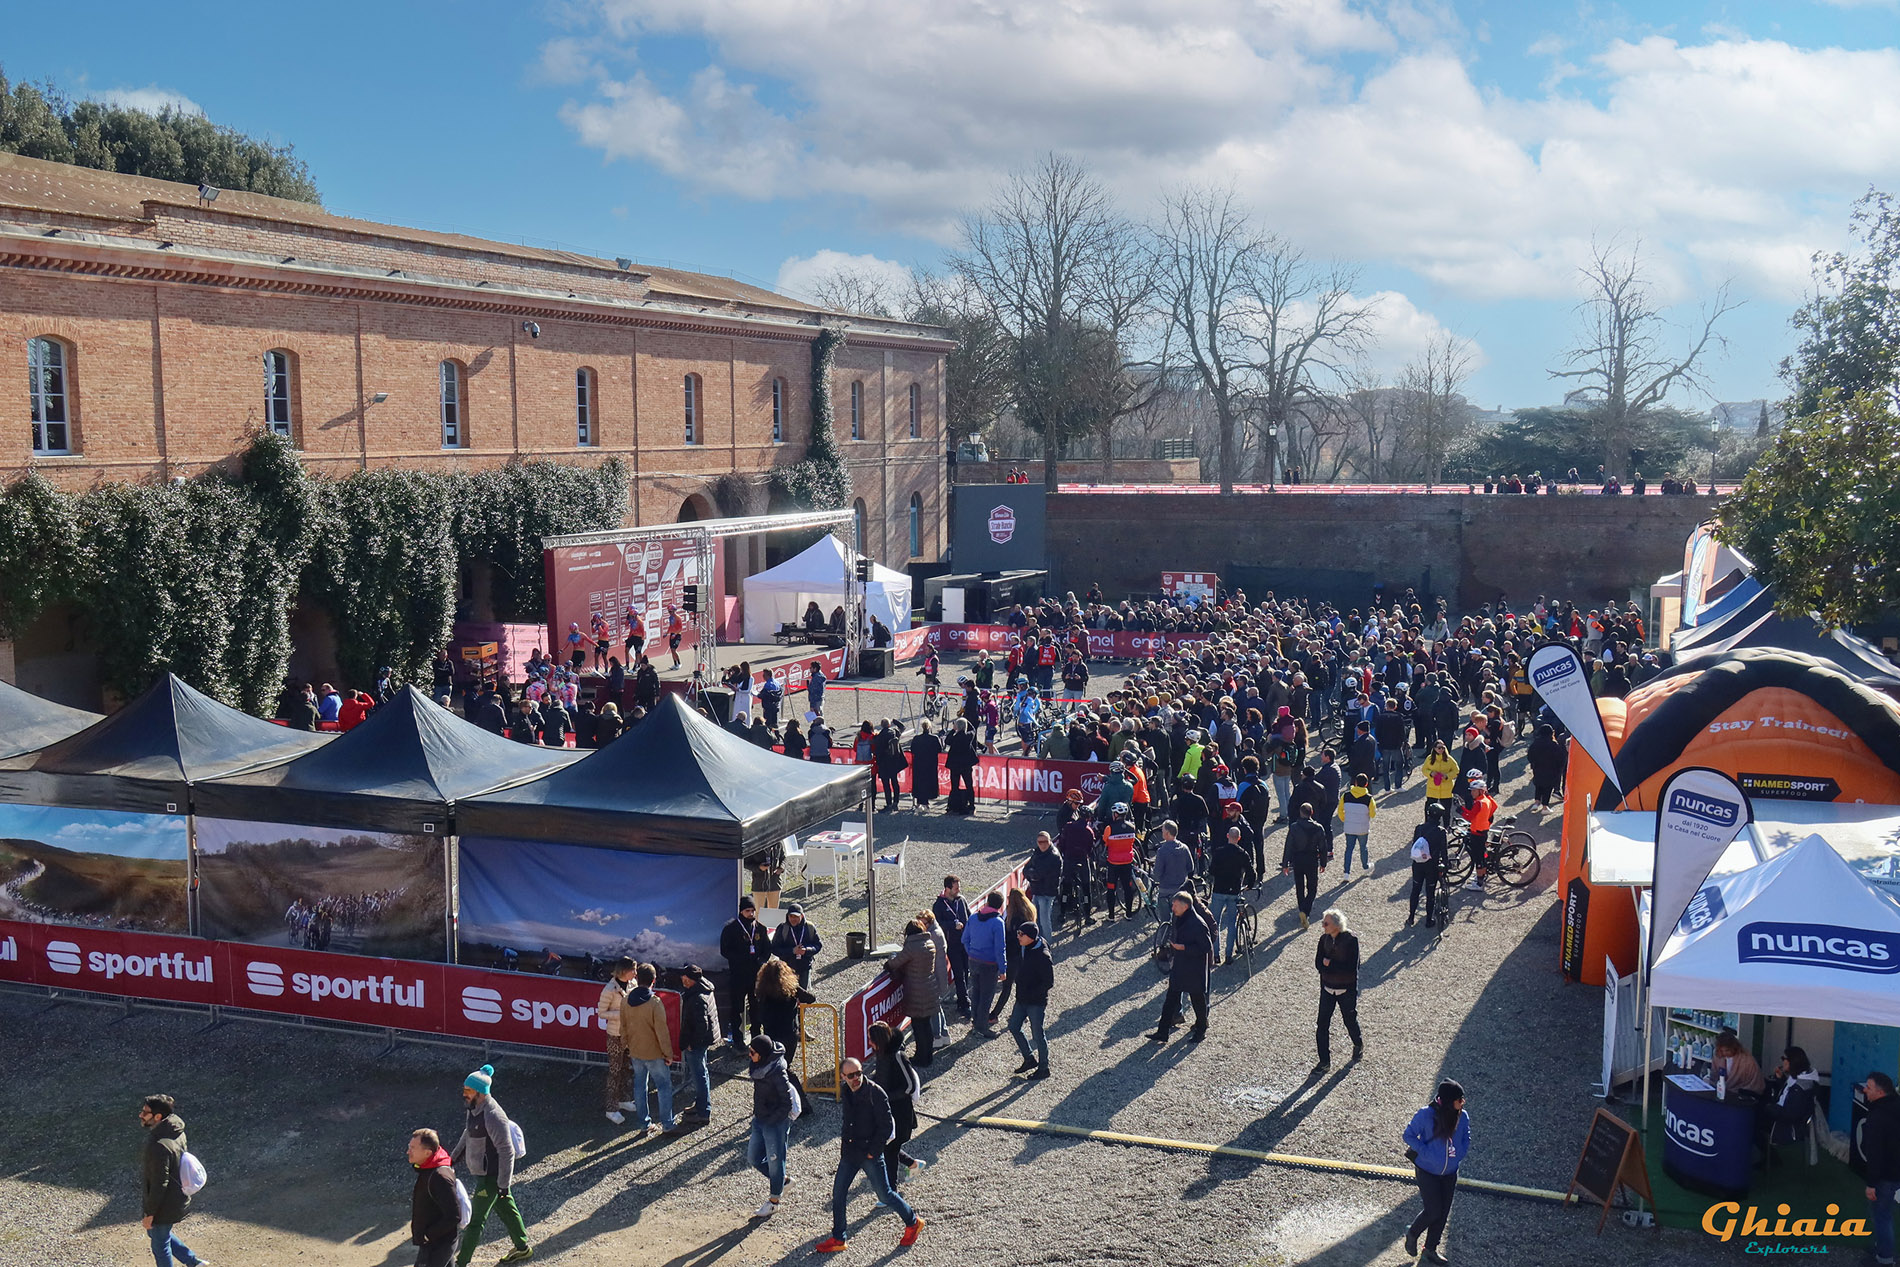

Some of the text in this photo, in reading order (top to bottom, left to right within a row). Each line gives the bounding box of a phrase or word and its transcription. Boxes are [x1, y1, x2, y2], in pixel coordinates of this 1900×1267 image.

[949, 628, 980, 641] enel
[1536, 660, 1573, 681] nuncas
[1709, 716, 1849, 740] Stay Trained!
[1753, 778, 1826, 792] NAMEDSPORT
[1760, 789, 1807, 797] SUPERFOOD
[1675, 794, 1733, 819] nuncas
[1667, 822, 1721, 843] la Casa nel Cuore
[1681, 819, 1709, 832] dal 1920
[1751, 932, 1890, 961] nuncas
[88, 950, 214, 983] sportful
[291, 972, 425, 1008] sportful
